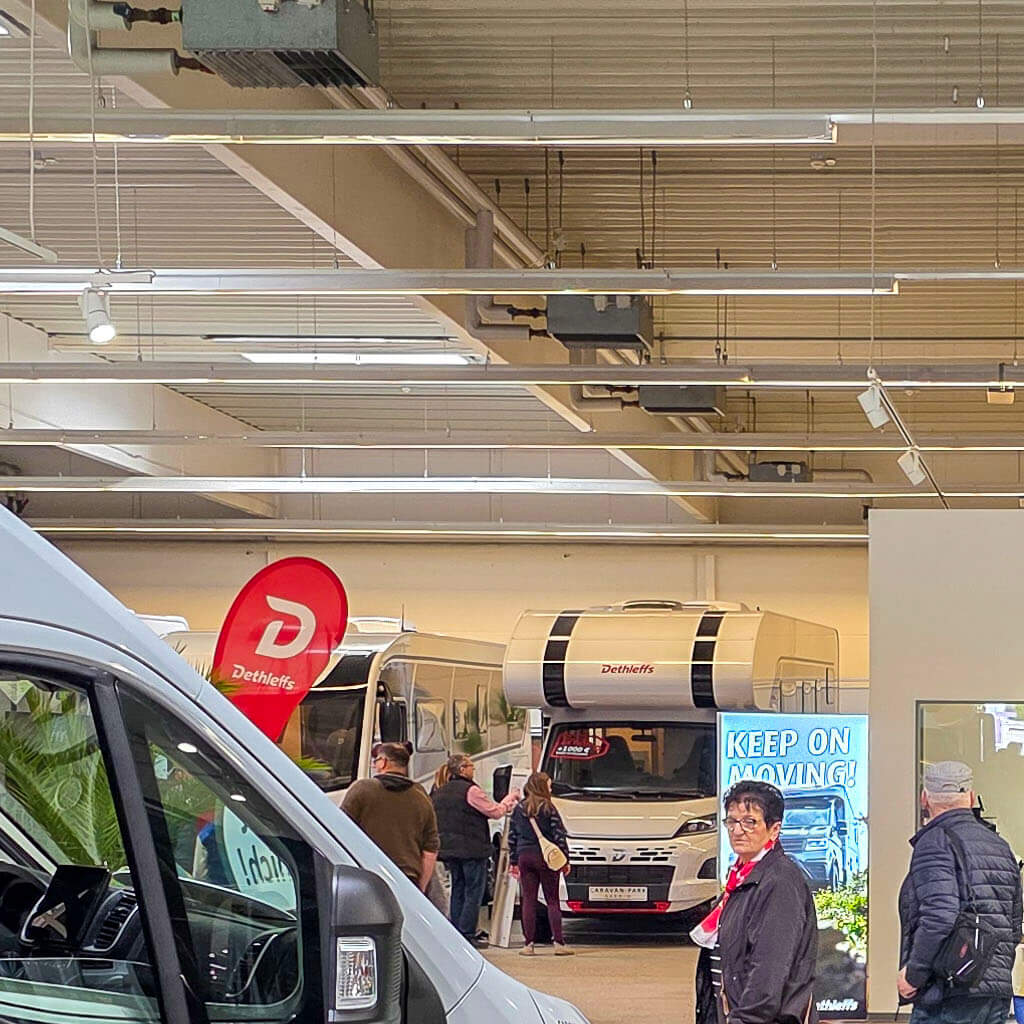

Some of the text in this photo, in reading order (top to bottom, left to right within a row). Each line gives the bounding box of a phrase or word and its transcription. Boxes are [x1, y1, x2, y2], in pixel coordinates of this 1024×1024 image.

[232, 663, 296, 691] Dethleffs
[601, 664, 655, 674] Dethleffs
[727, 726, 851, 759] KEEP ON
[728, 760, 857, 788] MOVING!
